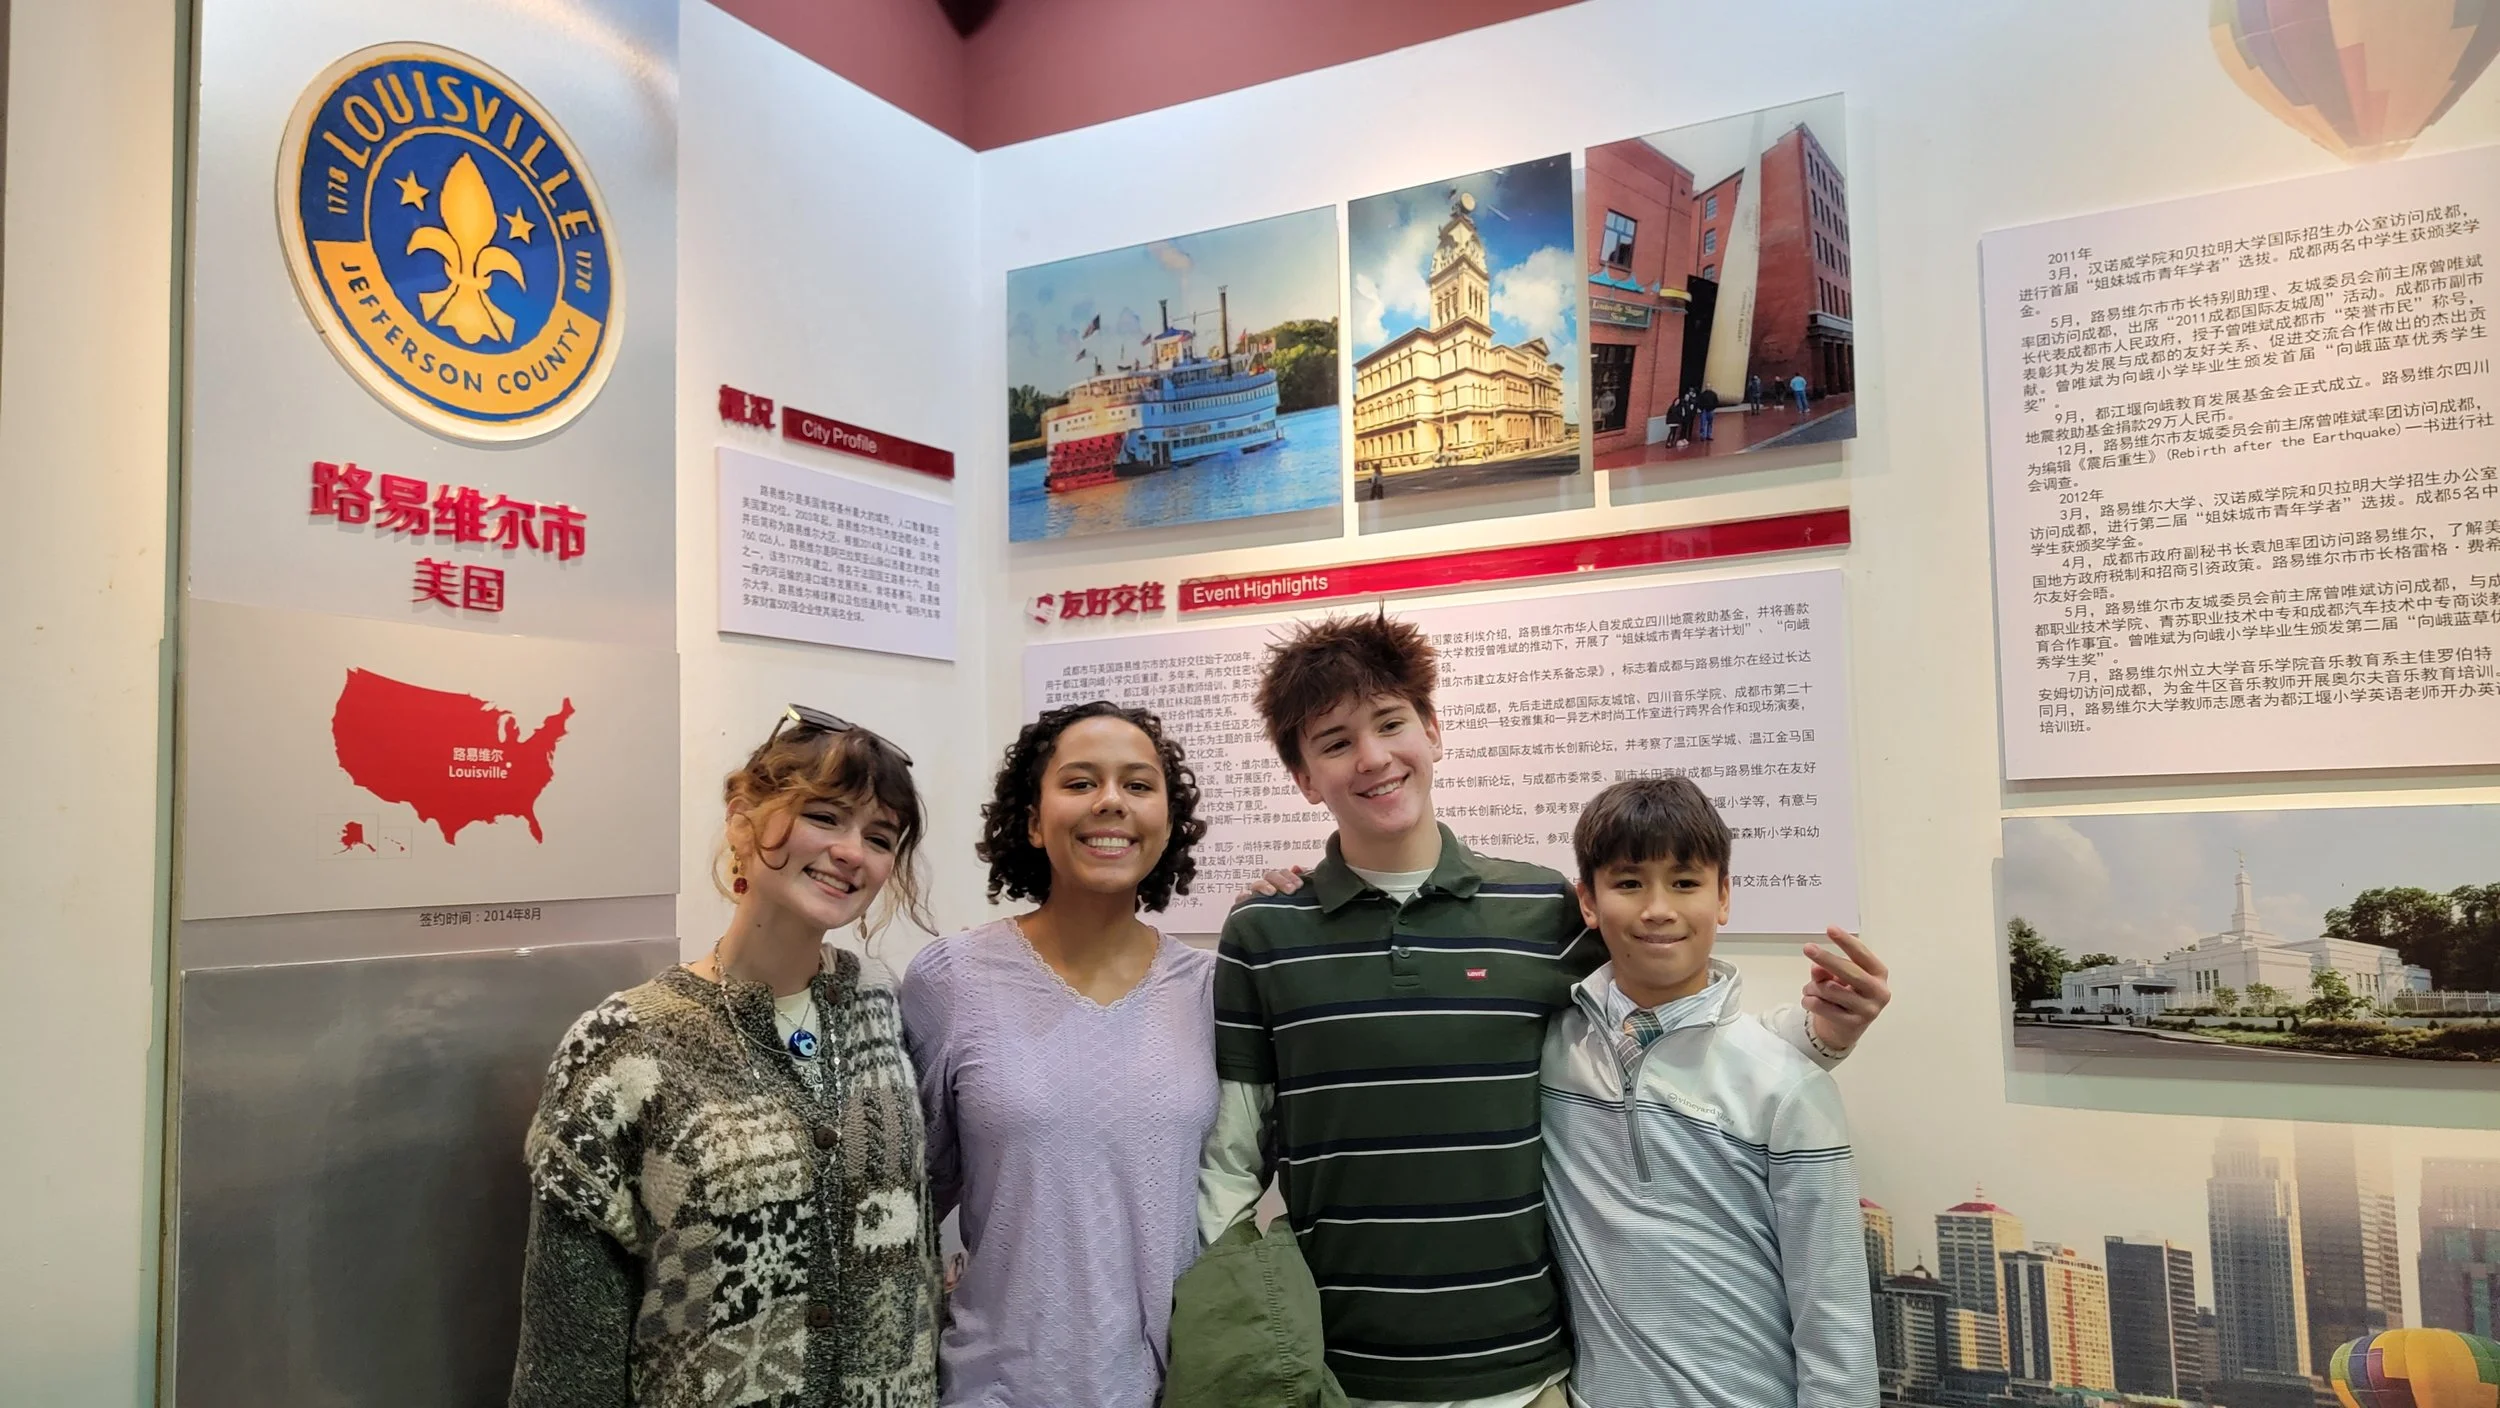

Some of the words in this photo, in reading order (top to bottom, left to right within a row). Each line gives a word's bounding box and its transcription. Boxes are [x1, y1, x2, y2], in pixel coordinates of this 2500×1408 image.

[322, 70, 598, 241] LOUISVILLE
[325, 164, 349, 215] 1778
[2048, 247, 2092, 265] 2011年
[573, 249, 593, 295] 1778
[339, 261, 484, 395] JEFFERSON
[496, 318, 583, 395] COUNTY
[801, 418, 831, 443] City
[832, 427, 879, 454] Profile
[2233, 439, 2272, 454] after
[2282, 434, 2305, 447] the
[2028, 477, 2079, 493] 会调查。
[2060, 489, 2104, 505] 2012年
[308, 460, 588, 562] 路易维尔市
[411, 556, 505, 612] 美国
[1193, 584, 1241, 604] Event
[1243, 574, 1329, 601] Highlights
[1059, 580, 1166, 619] 友好交往
[2040, 719, 2093, 735] 培训班。
[452, 747, 504, 763] 路易维尔
[448, 764, 508, 780] Louisville
[1678, 1096, 1716, 1114] vineyard
